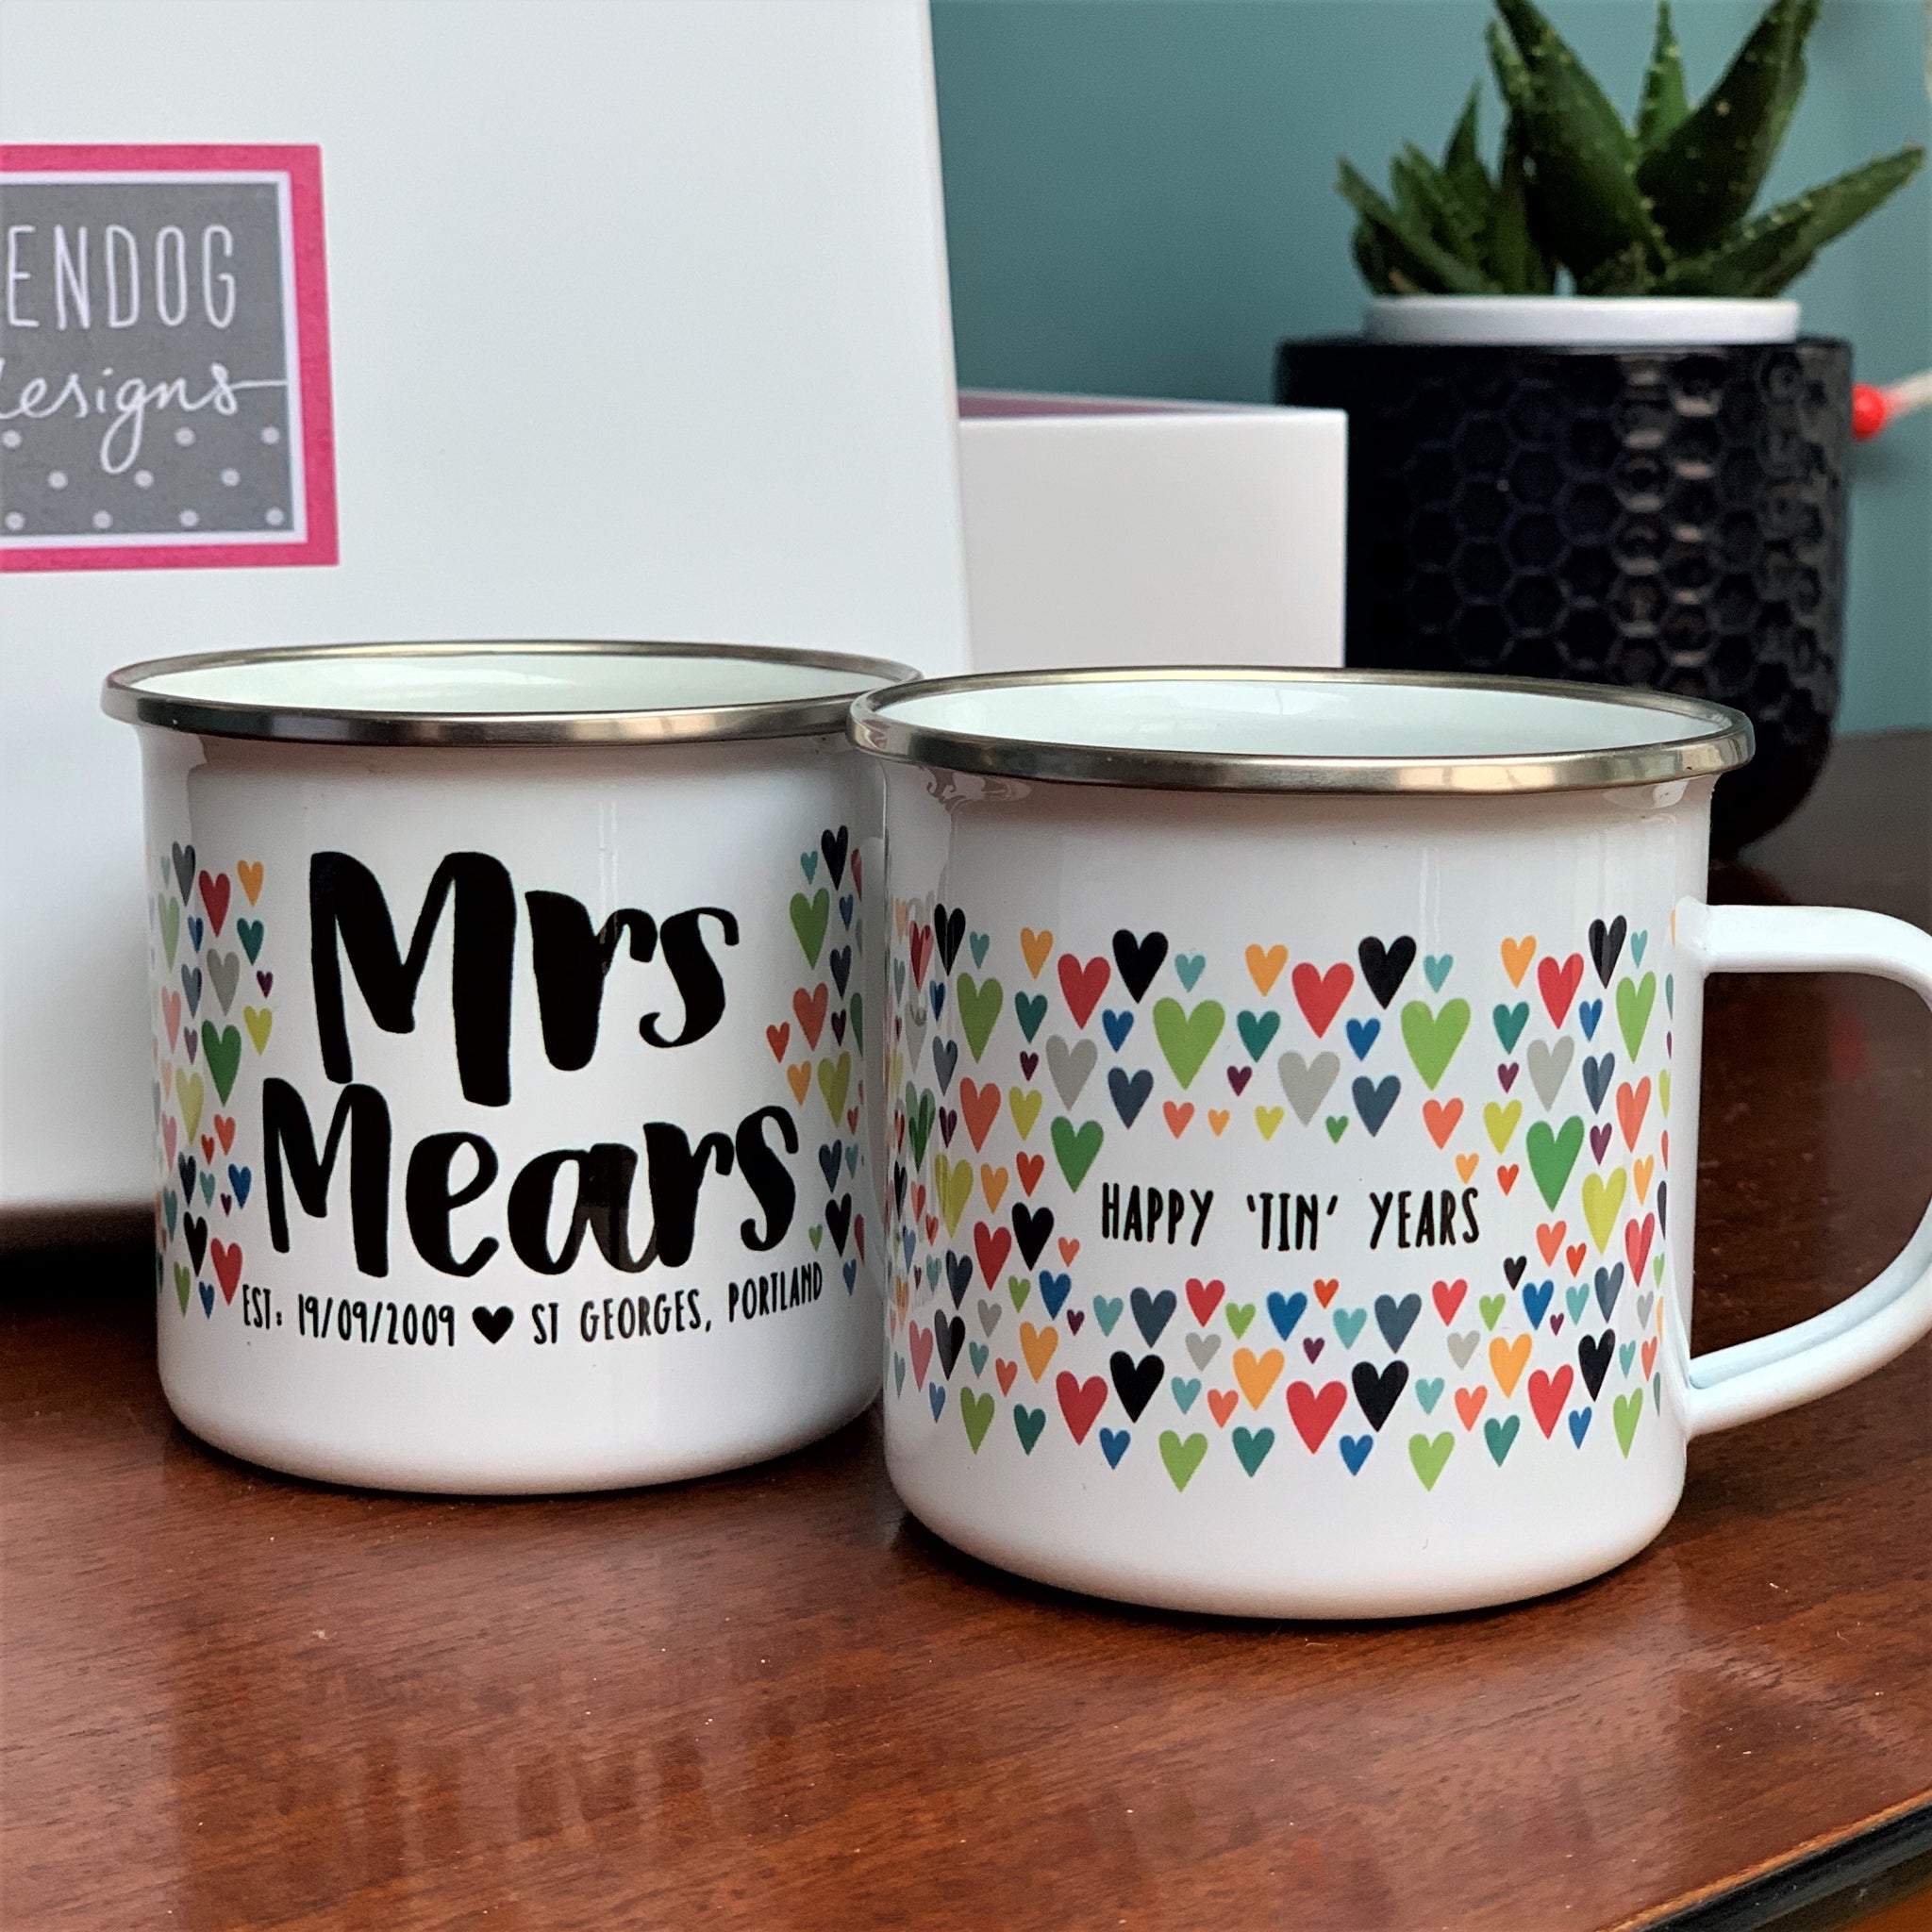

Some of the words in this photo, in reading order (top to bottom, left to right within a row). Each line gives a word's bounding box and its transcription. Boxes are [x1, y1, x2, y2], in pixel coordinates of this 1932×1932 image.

[309, 851, 740, 1108] Mrs
[262, 1077, 799, 1278] Mears
[1102, 1183, 1214, 1246] HAPPY
[1370, 1188, 1479, 1250] YEARS
[297, 1293, 456, 1347] 19/09/2009
[532, 1302, 559, 1345] ST
[580, 1289, 712, 1341] GEORGES,
[728, 1261, 824, 1323] PORTLAND
